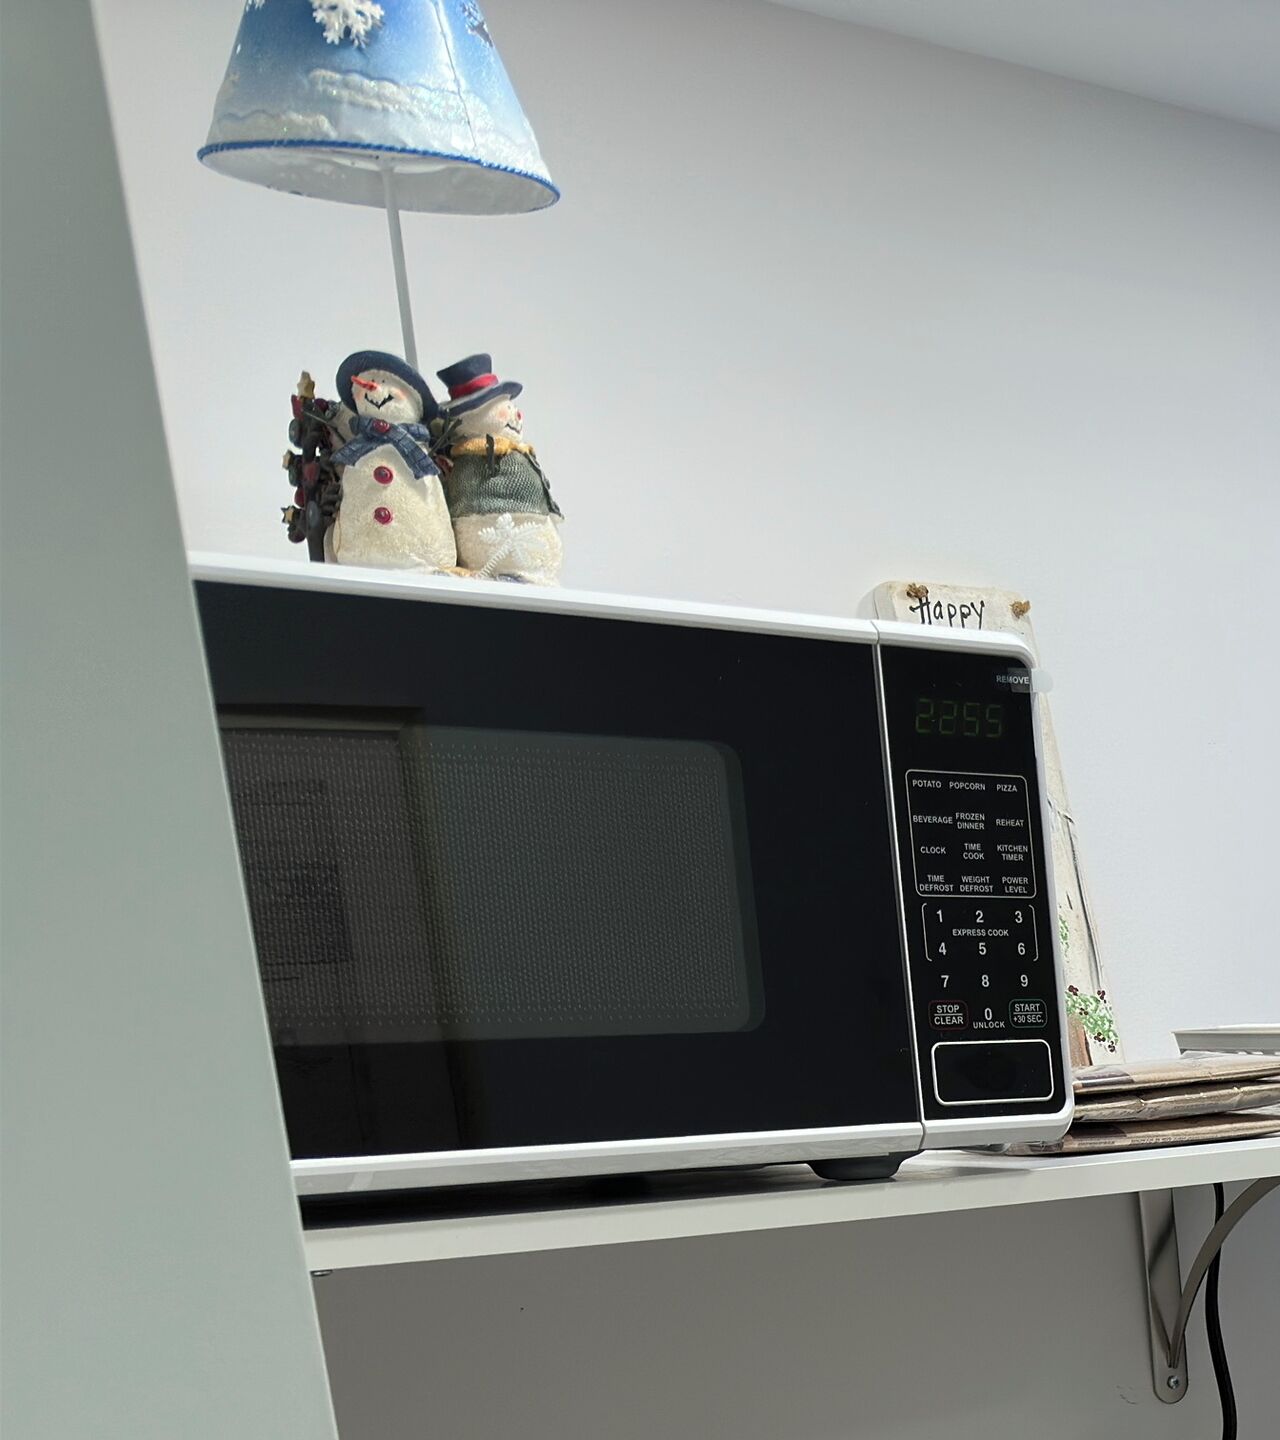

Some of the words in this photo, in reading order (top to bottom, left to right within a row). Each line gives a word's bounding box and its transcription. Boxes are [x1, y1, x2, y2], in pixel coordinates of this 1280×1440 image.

[910, 594, 985, 630] Happy
[996, 674, 1029, 685] REMOVE
[912, 780, 942, 789] POTATO
[949, 782, 986, 791] POPCORN
[996, 784, 1018, 793] PIZZA
[913, 815, 953, 825] BEVERAGE
[955, 812, 985, 821] FROZEN
[957, 821, 985, 830] DINNER
[996, 818, 1024, 827] REHEAT
[920, 846, 946, 854] CLOCK
[964, 843, 982, 851] TIME
[997, 844, 1028, 853] KITCHEN
[963, 852, 985, 860] COOK
[1002, 853, 1024, 861] TIMER
[961, 875, 990, 883] WEIGHT
[1002, 876, 1029, 884] POWER
[919, 884, 954, 892] DEFROST
[960, 884, 993, 893] DEFROST
[1004, 885, 1028, 894] LEVEL
[936, 911, 943, 922] 1
[976, 911, 984, 923] 2
[1015, 911, 1023, 923] 3
[952, 928, 986, 936] EXPRESS
[938, 943, 947, 955] 4
[979, 943, 987, 955] 5
[1017, 943, 1026, 955] 6
[941, 975, 949, 987] 7
[981, 975, 990, 988] 8
[1020, 975, 1029, 987] 9
[936, 1005, 960, 1014] STOP
[1014, 1003, 1040, 1012] START
[934, 1016, 964, 1025] CLEAR
[1013, 1015, 1025, 1023] +30
[1026, 1014, 1044, 1023] SEC.
[973, 1021, 1005, 1029] UNLOCK
